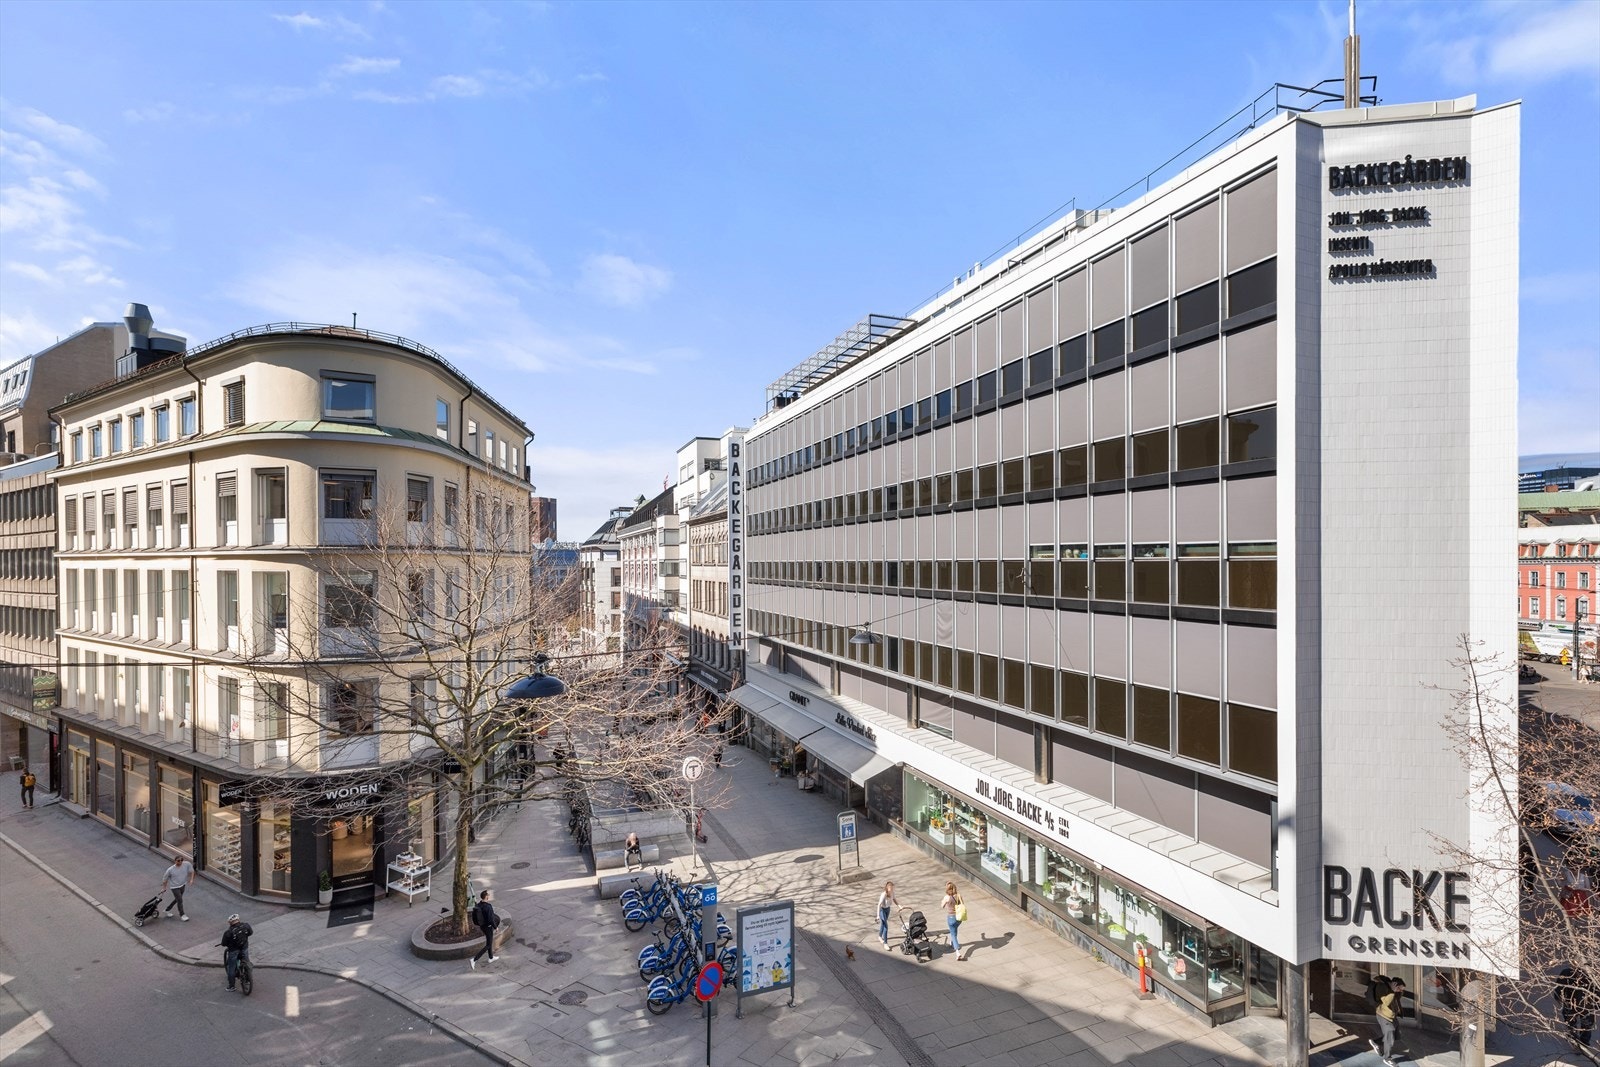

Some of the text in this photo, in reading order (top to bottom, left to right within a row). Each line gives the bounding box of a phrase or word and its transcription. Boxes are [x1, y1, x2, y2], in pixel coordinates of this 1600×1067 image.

[1328, 154, 1467, 189] BACKEGÅRDEN
[1392, 206, 1427, 222] BACKE
[1328, 236, 1369, 252] INSENTI
[1328, 258, 1433, 279] APOLLO HÅRSENTER
[688, 765, 699, 778] T
[220, 789, 243, 798] WODEN
[325, 783, 378, 800] WODEN
[335, 799, 367, 809] WODEN
[976, 778, 992, 800] JOH.
[993, 787, 1015, 811] JØRG.
[1016, 797, 1042, 825] BACKE
[1324, 865, 1471, 933] BACKE
[1324, 933, 1471, 960] I GRENSEN
